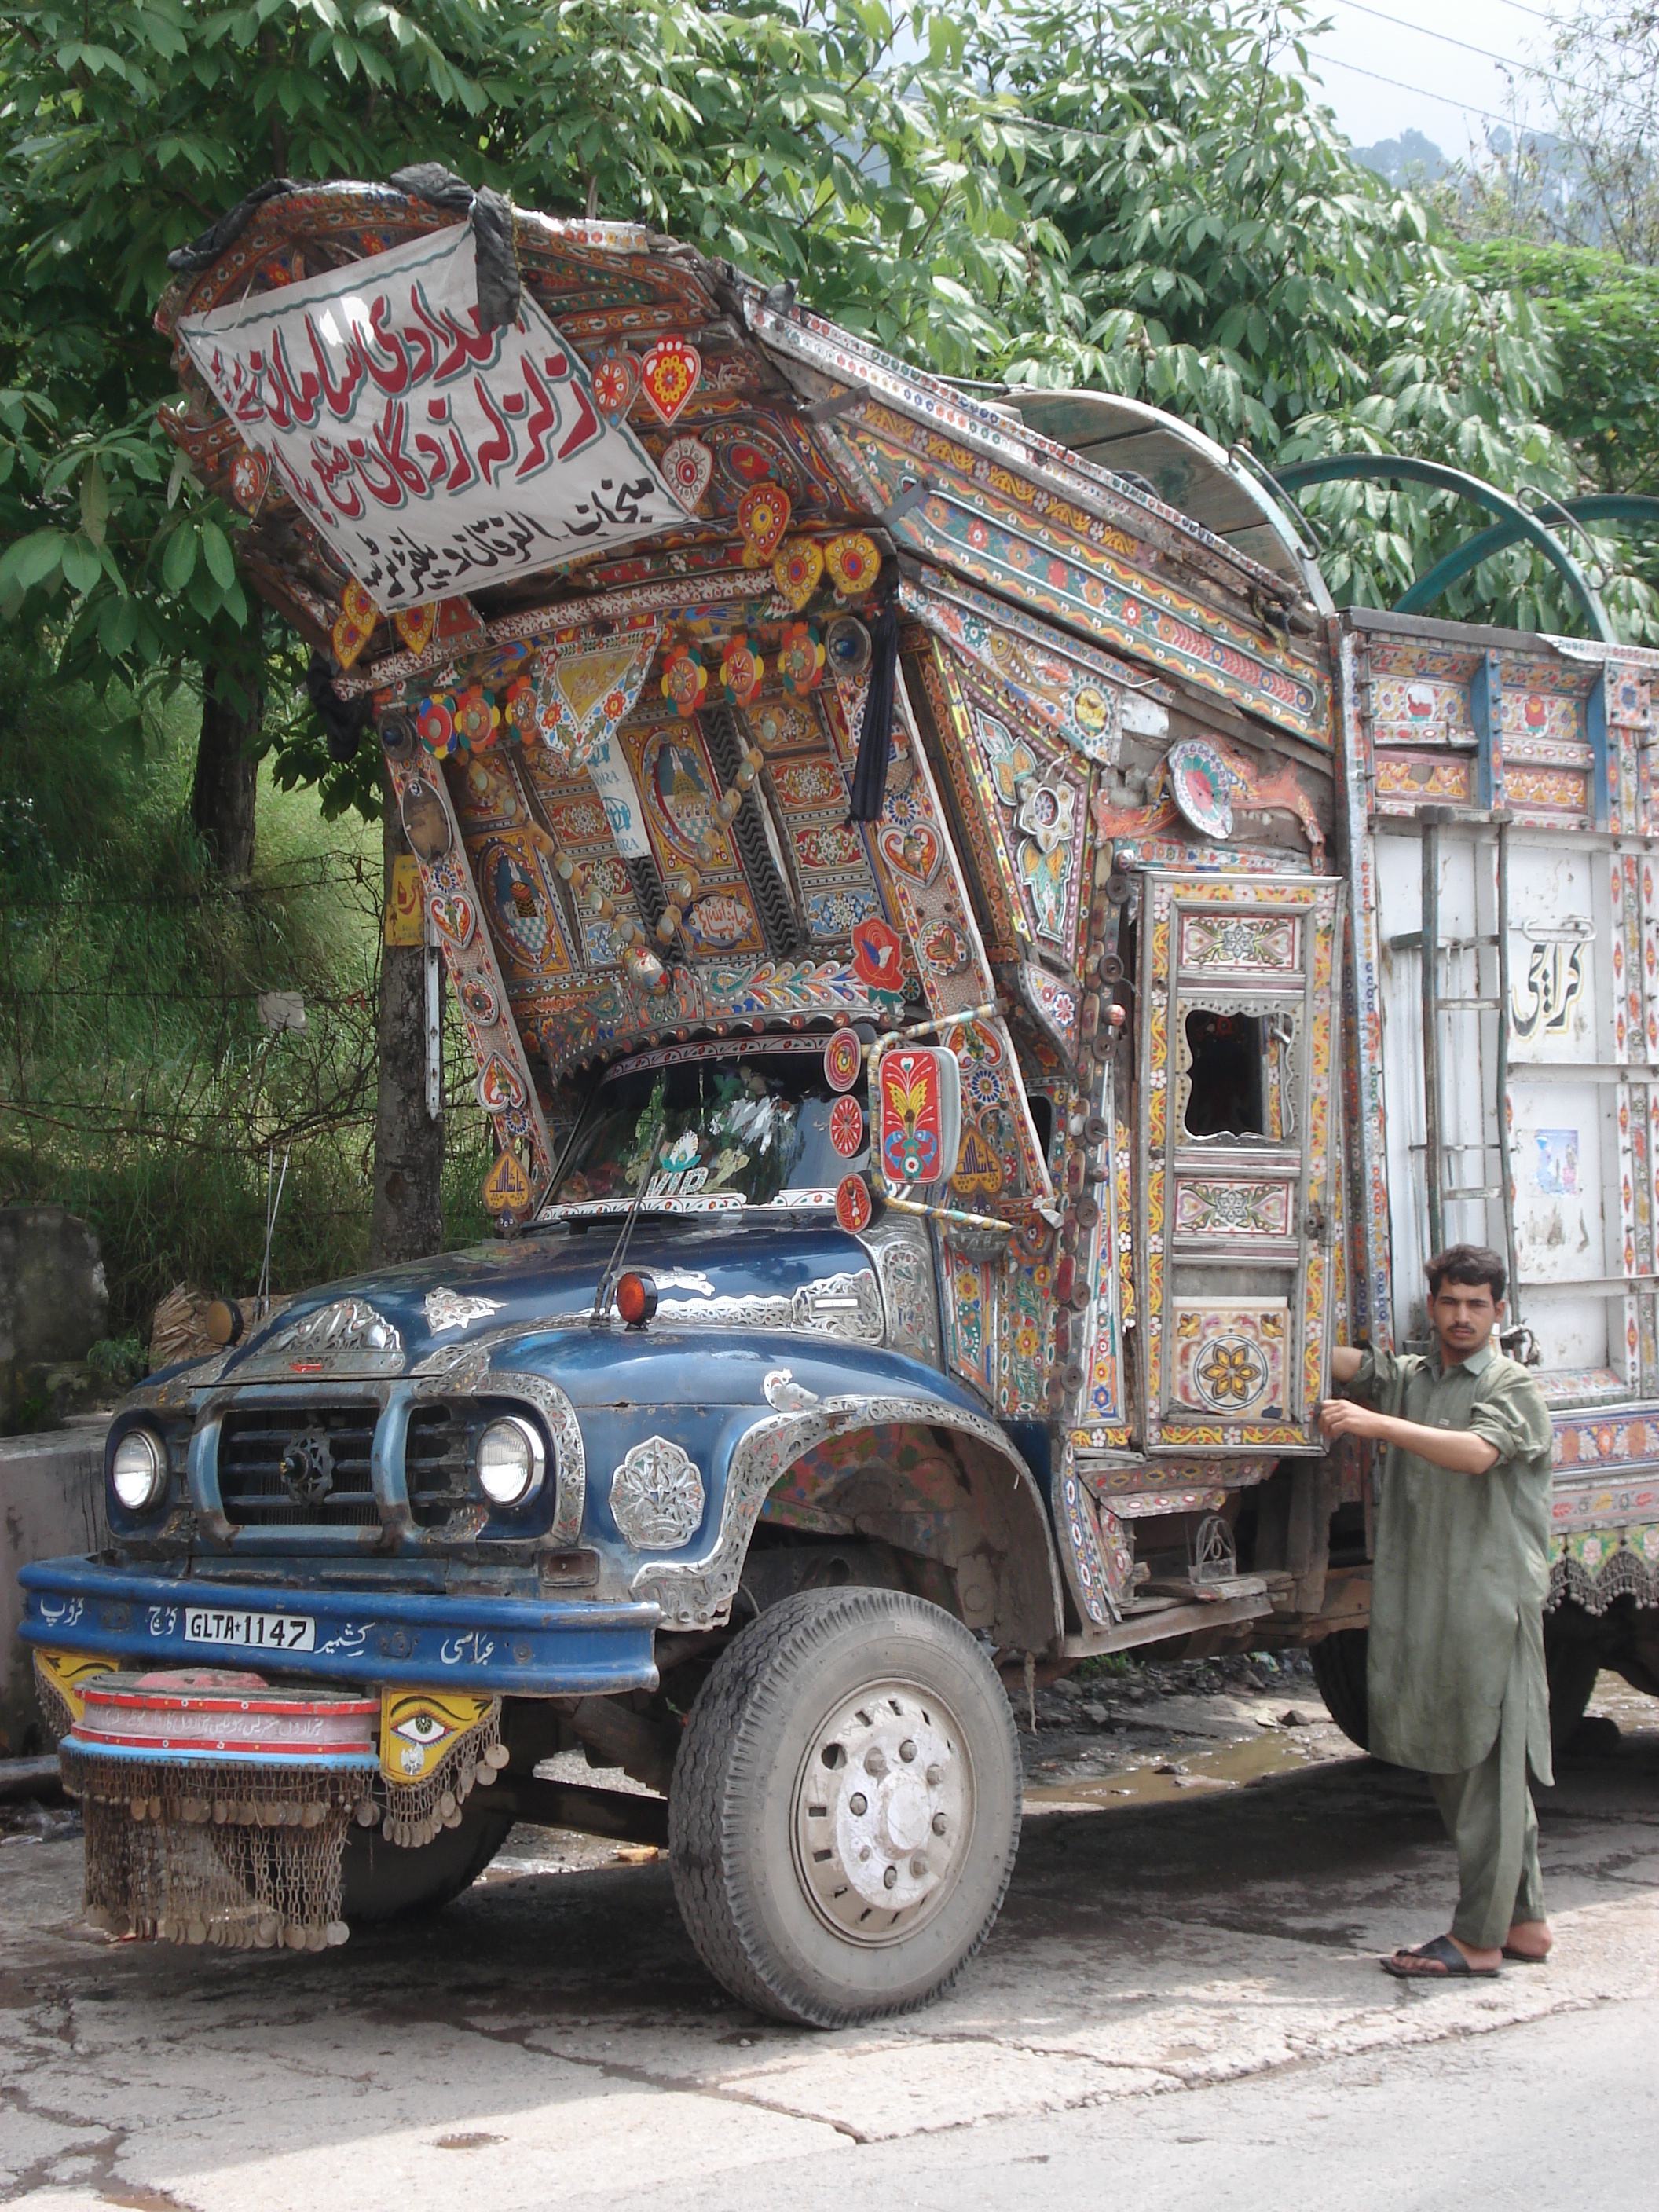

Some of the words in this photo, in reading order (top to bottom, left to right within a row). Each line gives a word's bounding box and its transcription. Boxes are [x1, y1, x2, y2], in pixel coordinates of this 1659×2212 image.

[251, 313, 364, 430] سامان
[347, 397, 473, 507] زدگان
[474, 351, 600, 486] زلزلہ
[309, 434, 362, 519] ضلع
[562, 477, 656, 537] منجانب
[452, 511, 562, 566] الفرقان
[1511, 943, 1583, 1037] کراچی
[646, 1166, 709, 1197] VIP
